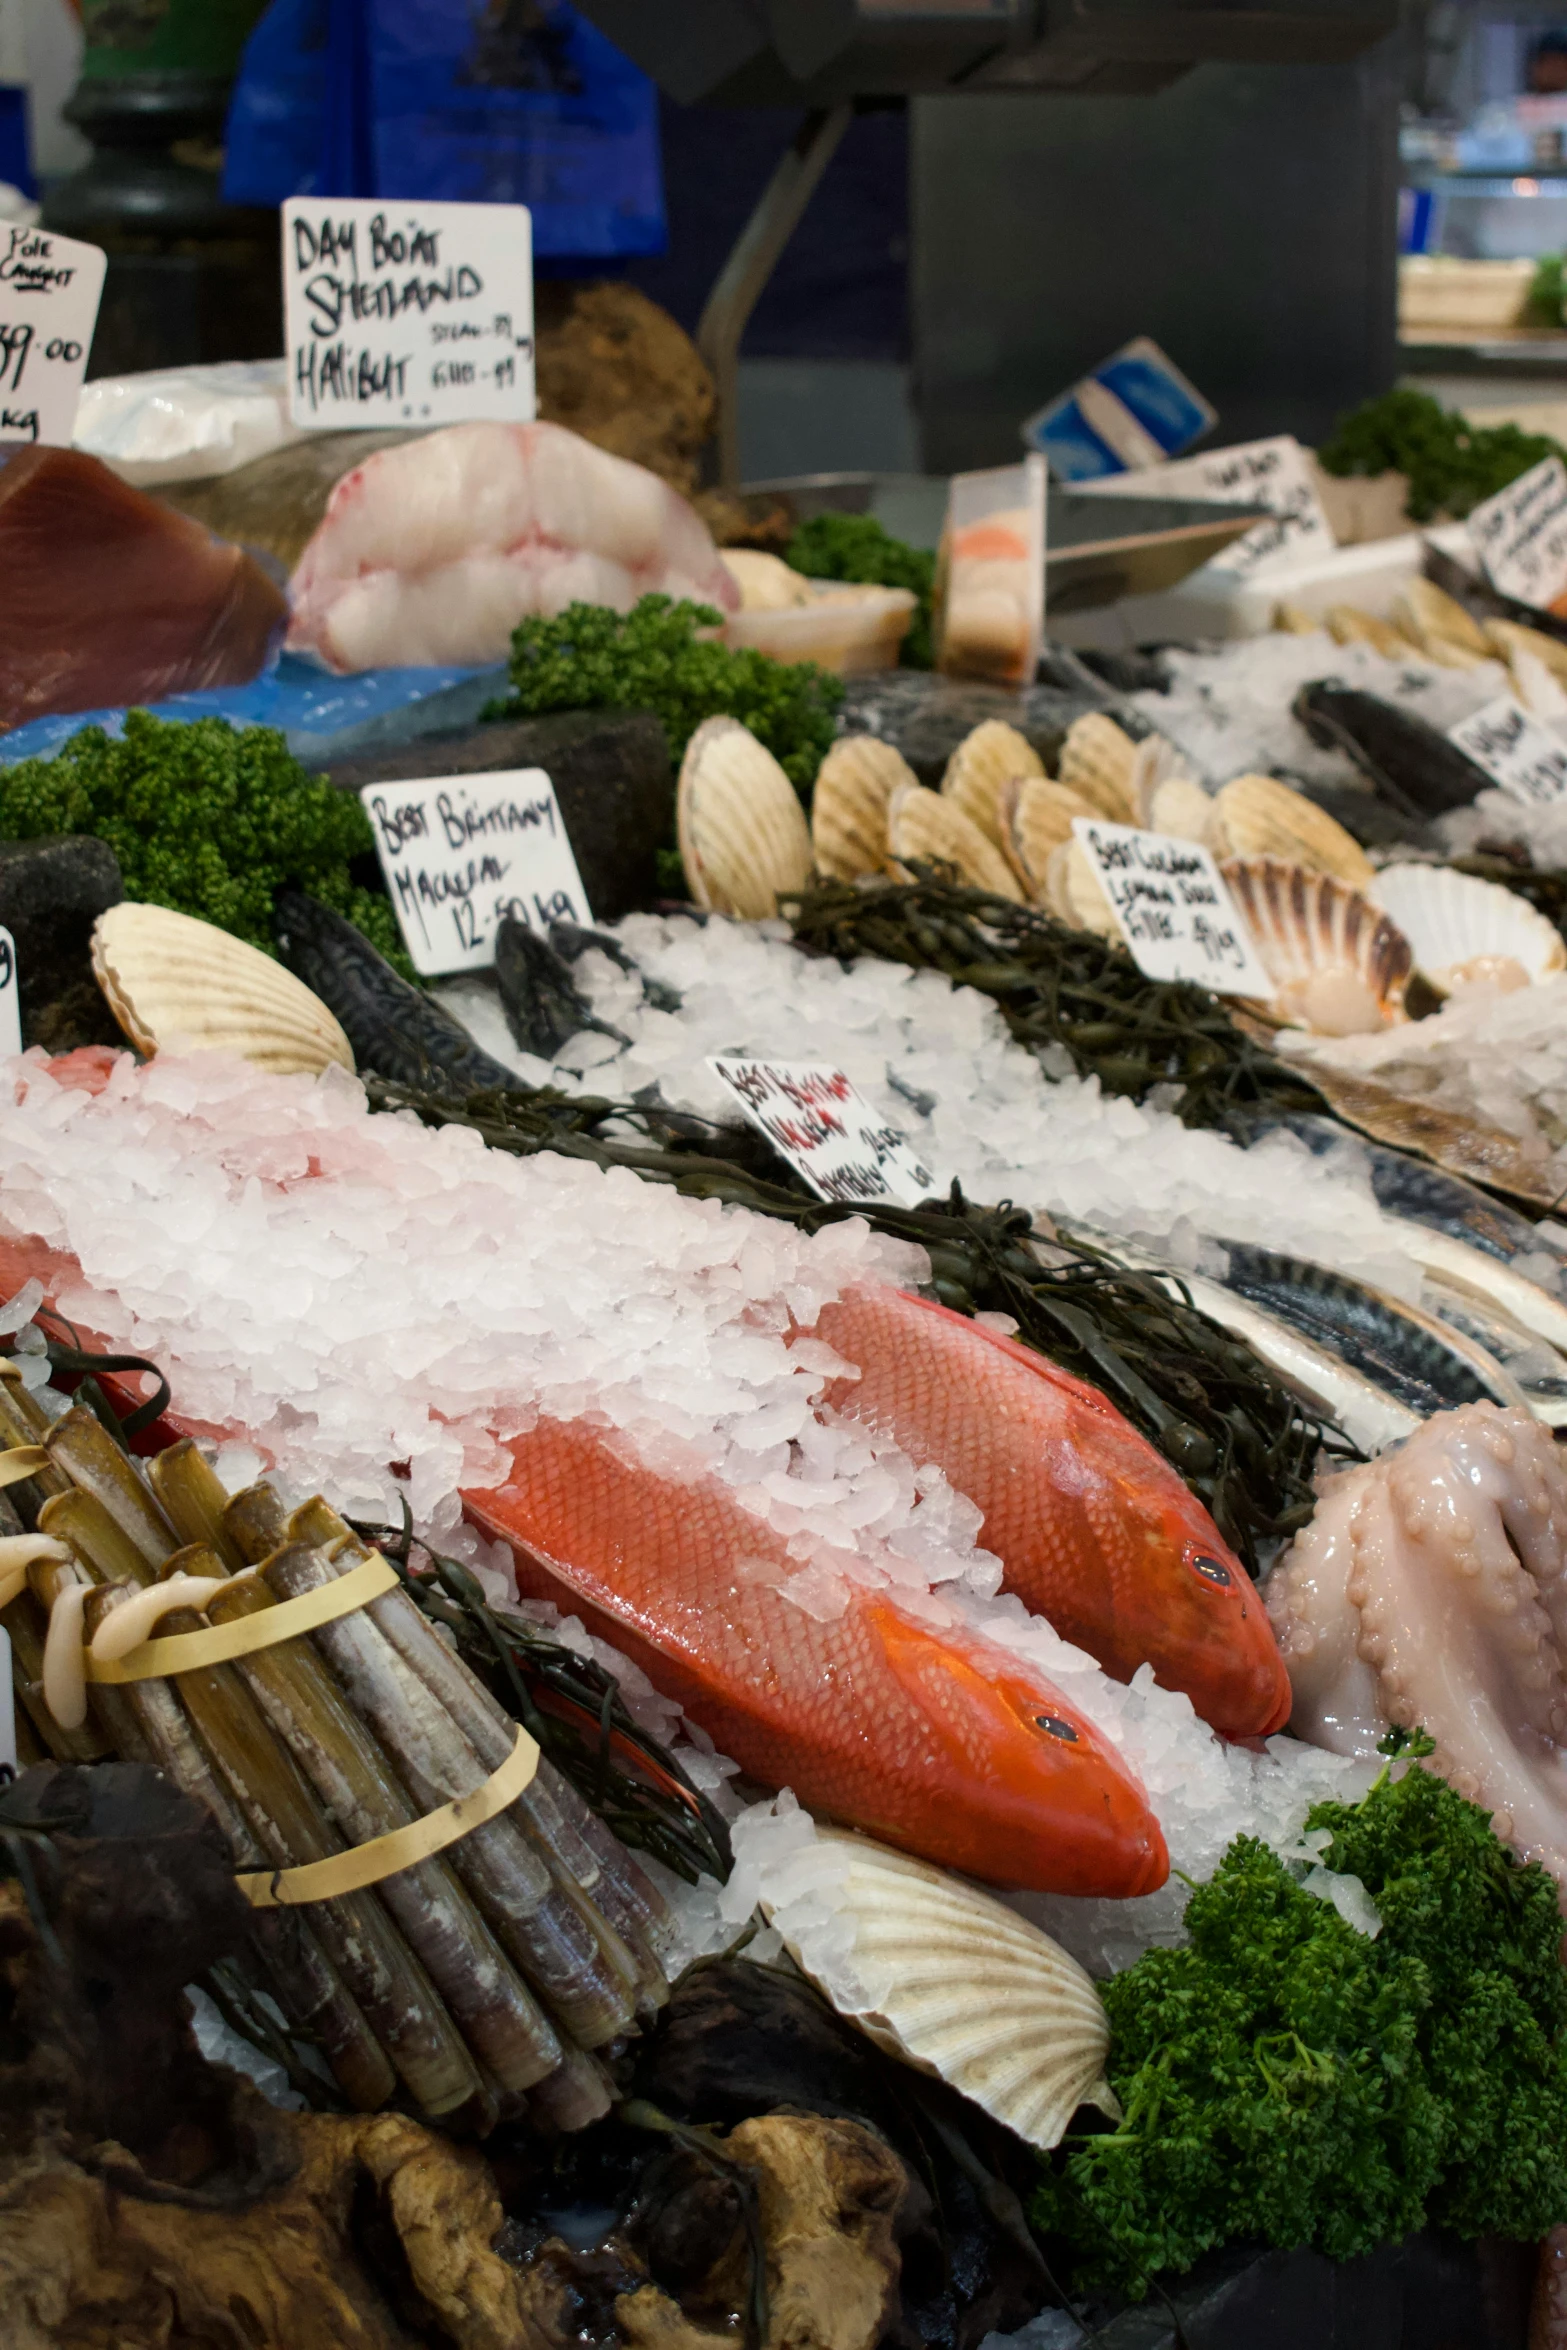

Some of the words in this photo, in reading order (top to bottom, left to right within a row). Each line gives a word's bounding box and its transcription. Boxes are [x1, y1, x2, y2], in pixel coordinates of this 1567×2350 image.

[293, 216, 359, 283] DAY
[369, 212, 441, 269] BOAT
[305, 266, 482, 337] SHETLAND
[373, 795, 428, 855] BEST
[715, 1061, 778, 1112] BEST
